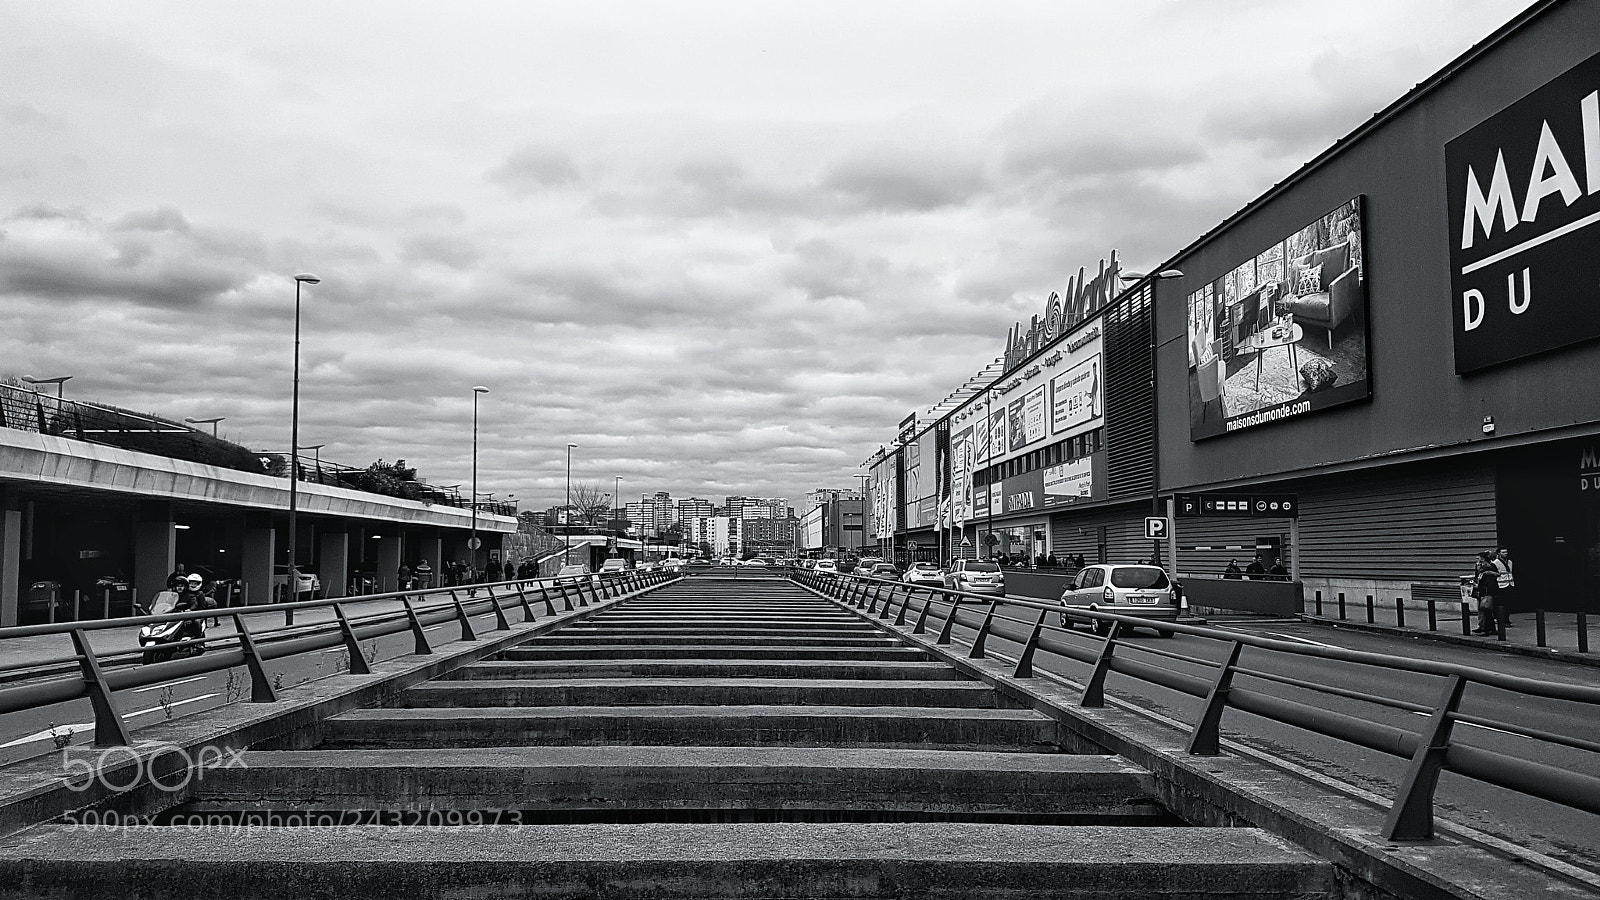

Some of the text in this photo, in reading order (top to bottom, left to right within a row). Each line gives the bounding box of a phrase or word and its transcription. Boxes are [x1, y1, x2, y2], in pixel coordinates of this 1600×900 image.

[1226, 400, 1311, 432] maisonsdumonde.com
[1185, 503, 1192, 512] P
[1150, 519, 1164, 536] P
